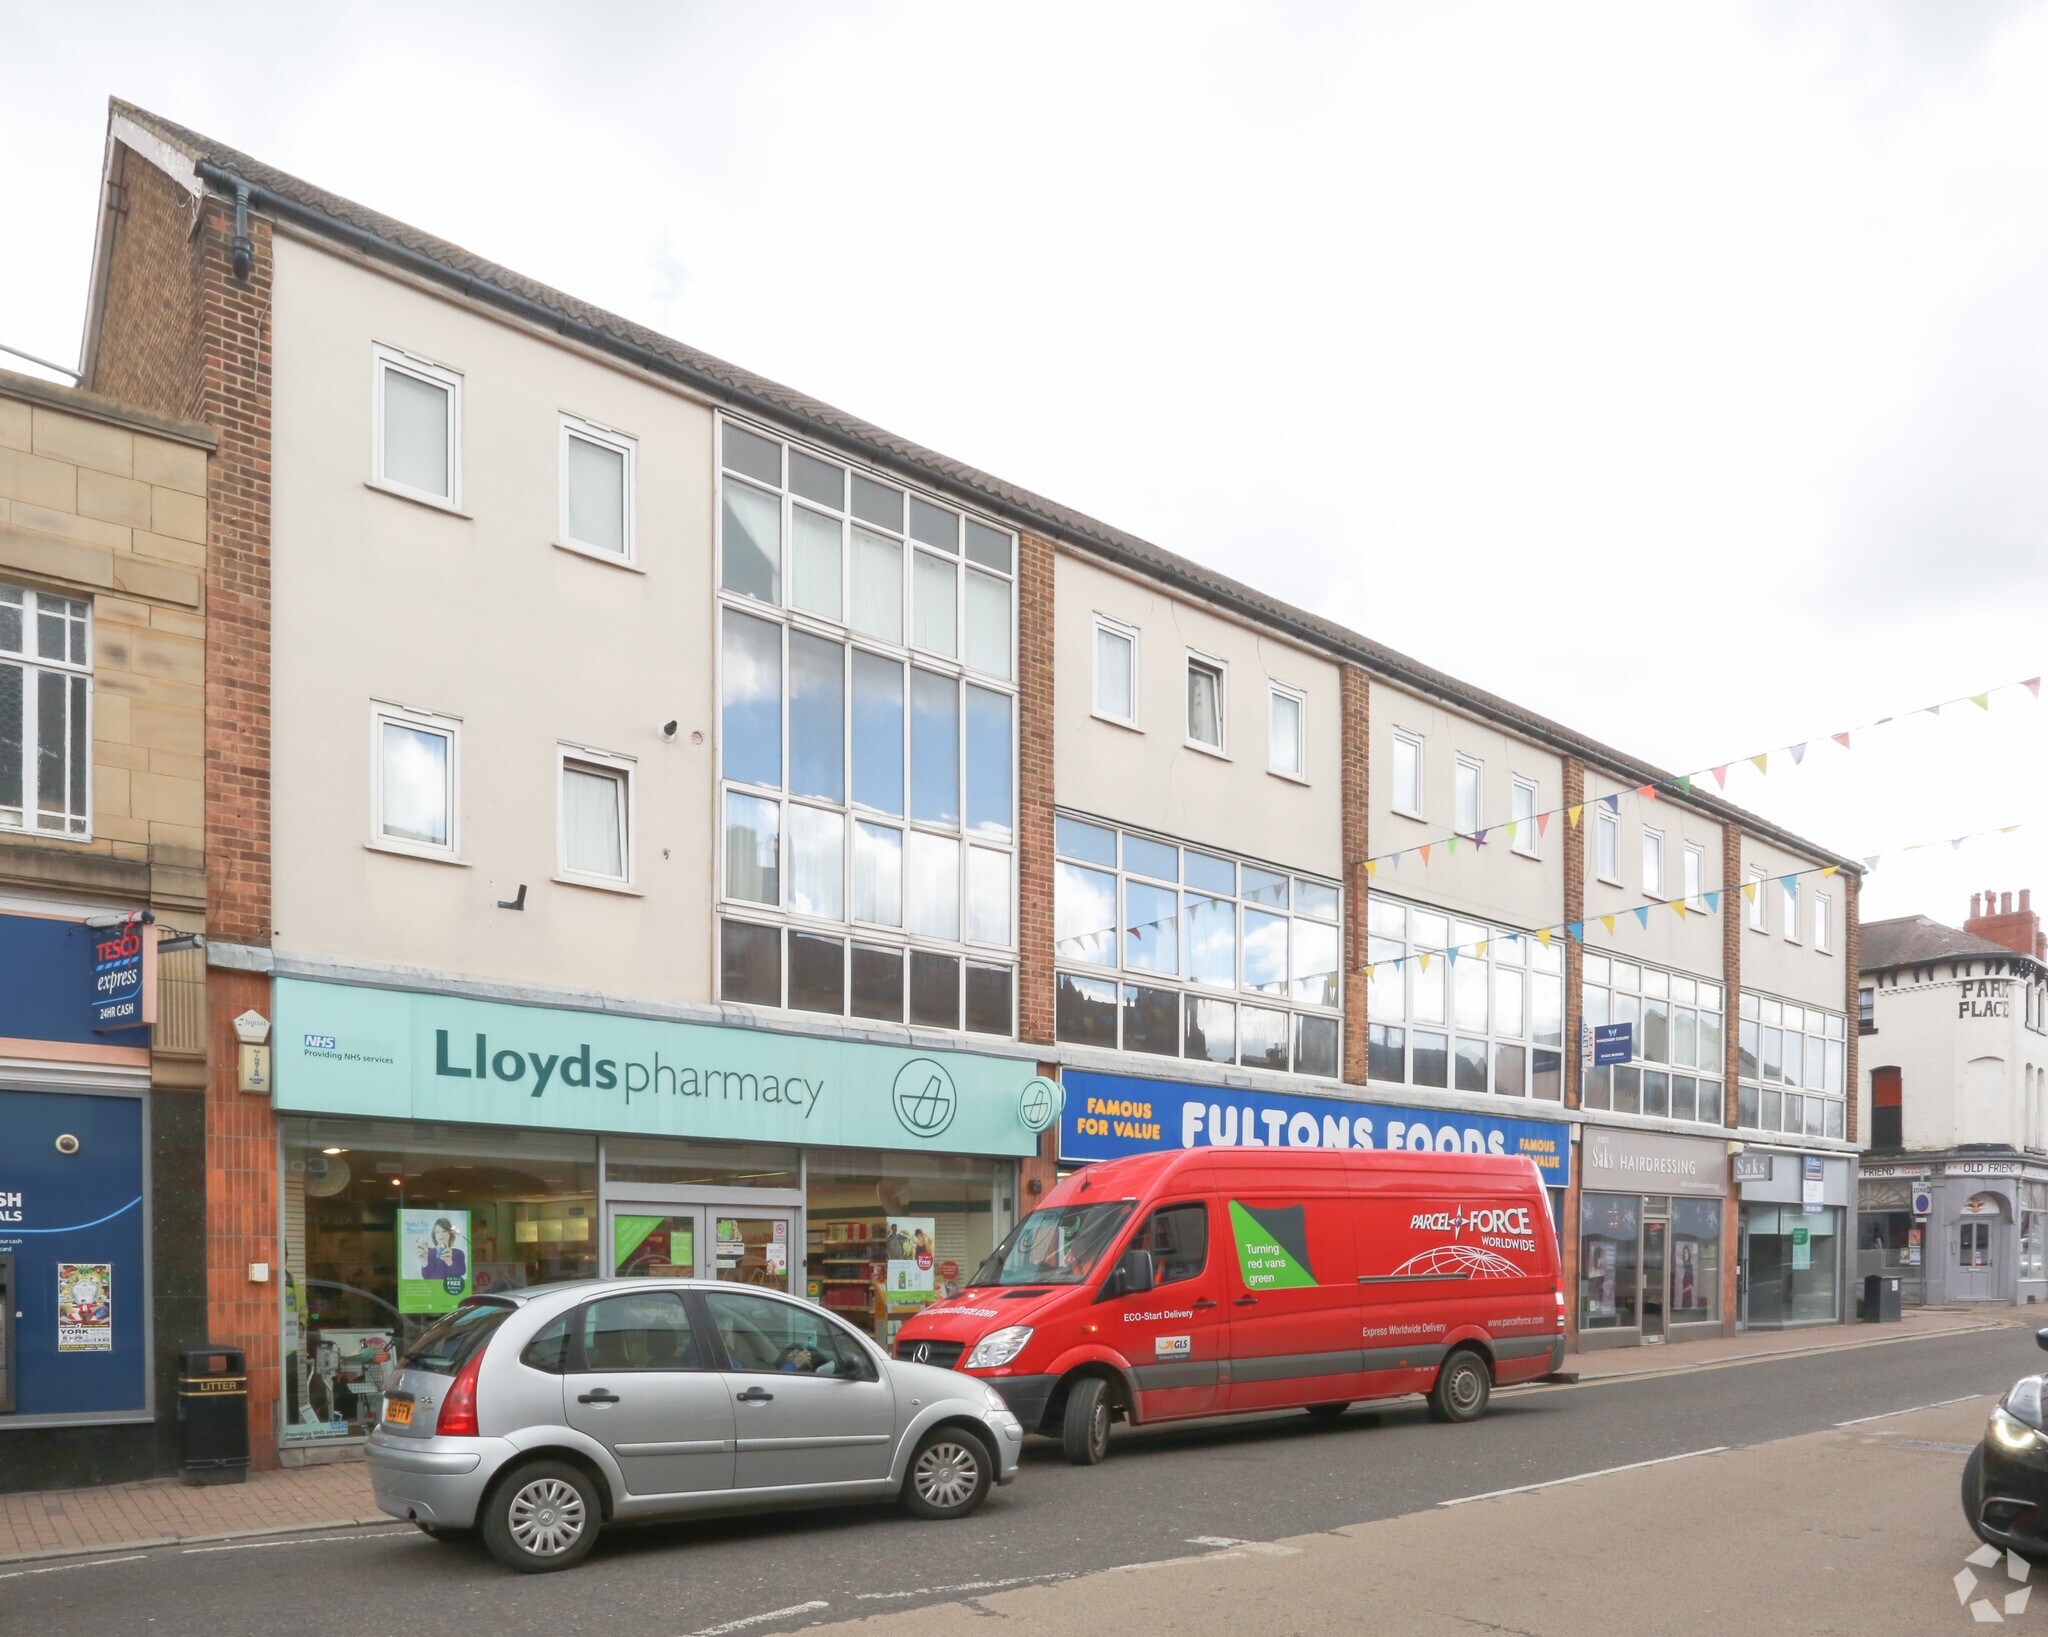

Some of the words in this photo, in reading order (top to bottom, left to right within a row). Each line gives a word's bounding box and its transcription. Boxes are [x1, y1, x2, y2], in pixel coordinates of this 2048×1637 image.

[96, 935, 140, 961] TESCO
[98, 969, 137, 994] express
[1962, 981, 2009, 998] PARK
[100, 1006, 116, 1020] 24HR
[116, 1003, 134, 1016] CASH
[1959, 1000, 2009, 1019] PLACE
[305, 1035, 335, 1049] NHS
[304, 1048, 342, 1060] Providing
[344, 1053, 361, 1061] NHS
[363, 1055, 394, 1064] services
[436, 1029, 824, 1118] Lloydspharmacy
[1087, 1097, 1152, 1119] FAMOUS
[1077, 1118, 1108, 1136] FOR
[1113, 1120, 1161, 1140] VALUE
[1182, 1101, 1373, 1149] FULTONS
[1387, 1121, 1505, 1155] FOODS
[1519, 1137, 1555, 1153] FAMOUS
[1533, 1155, 1560, 1168] VALUE
[1592, 1145, 1613, 1169] Saks
[1620, 1155, 1696, 1175] HAIRDRESSING
[1737, 1159, 1765, 1175] Saks
[1963, 1162, 1984, 1173] OLD
[1988, 1163, 2015, 1173] FRIEND
[1863, 1166, 1895, 1177] FRIEND
[1410, 1213, 1451, 1230] PARCEL
[1469, 1208, 1532, 1235] FORCE
[1246, 1243, 1280, 1256] Turning
[1481, 1236, 1535, 1252] WORLDWIDE
[1248, 1258, 1263, 1268] red
[1265, 1259, 1286, 1268] vans
[1249, 1274, 1275, 1286] green
[1124, 1312, 1162, 1322] ECO-Start
[1164, 1310, 1193, 1319] Delivery
[1487, 1316, 1544, 1327] www.parcelforce.com
[1362, 1325, 1388, 1338] Express
[1389, 1324, 1421, 1335] Worldwide
[1422, 1322, 1446, 1333] Delivery
[1174, 1340, 1187, 1349] GLS
[201, 1381, 236, 1390] LITTER
